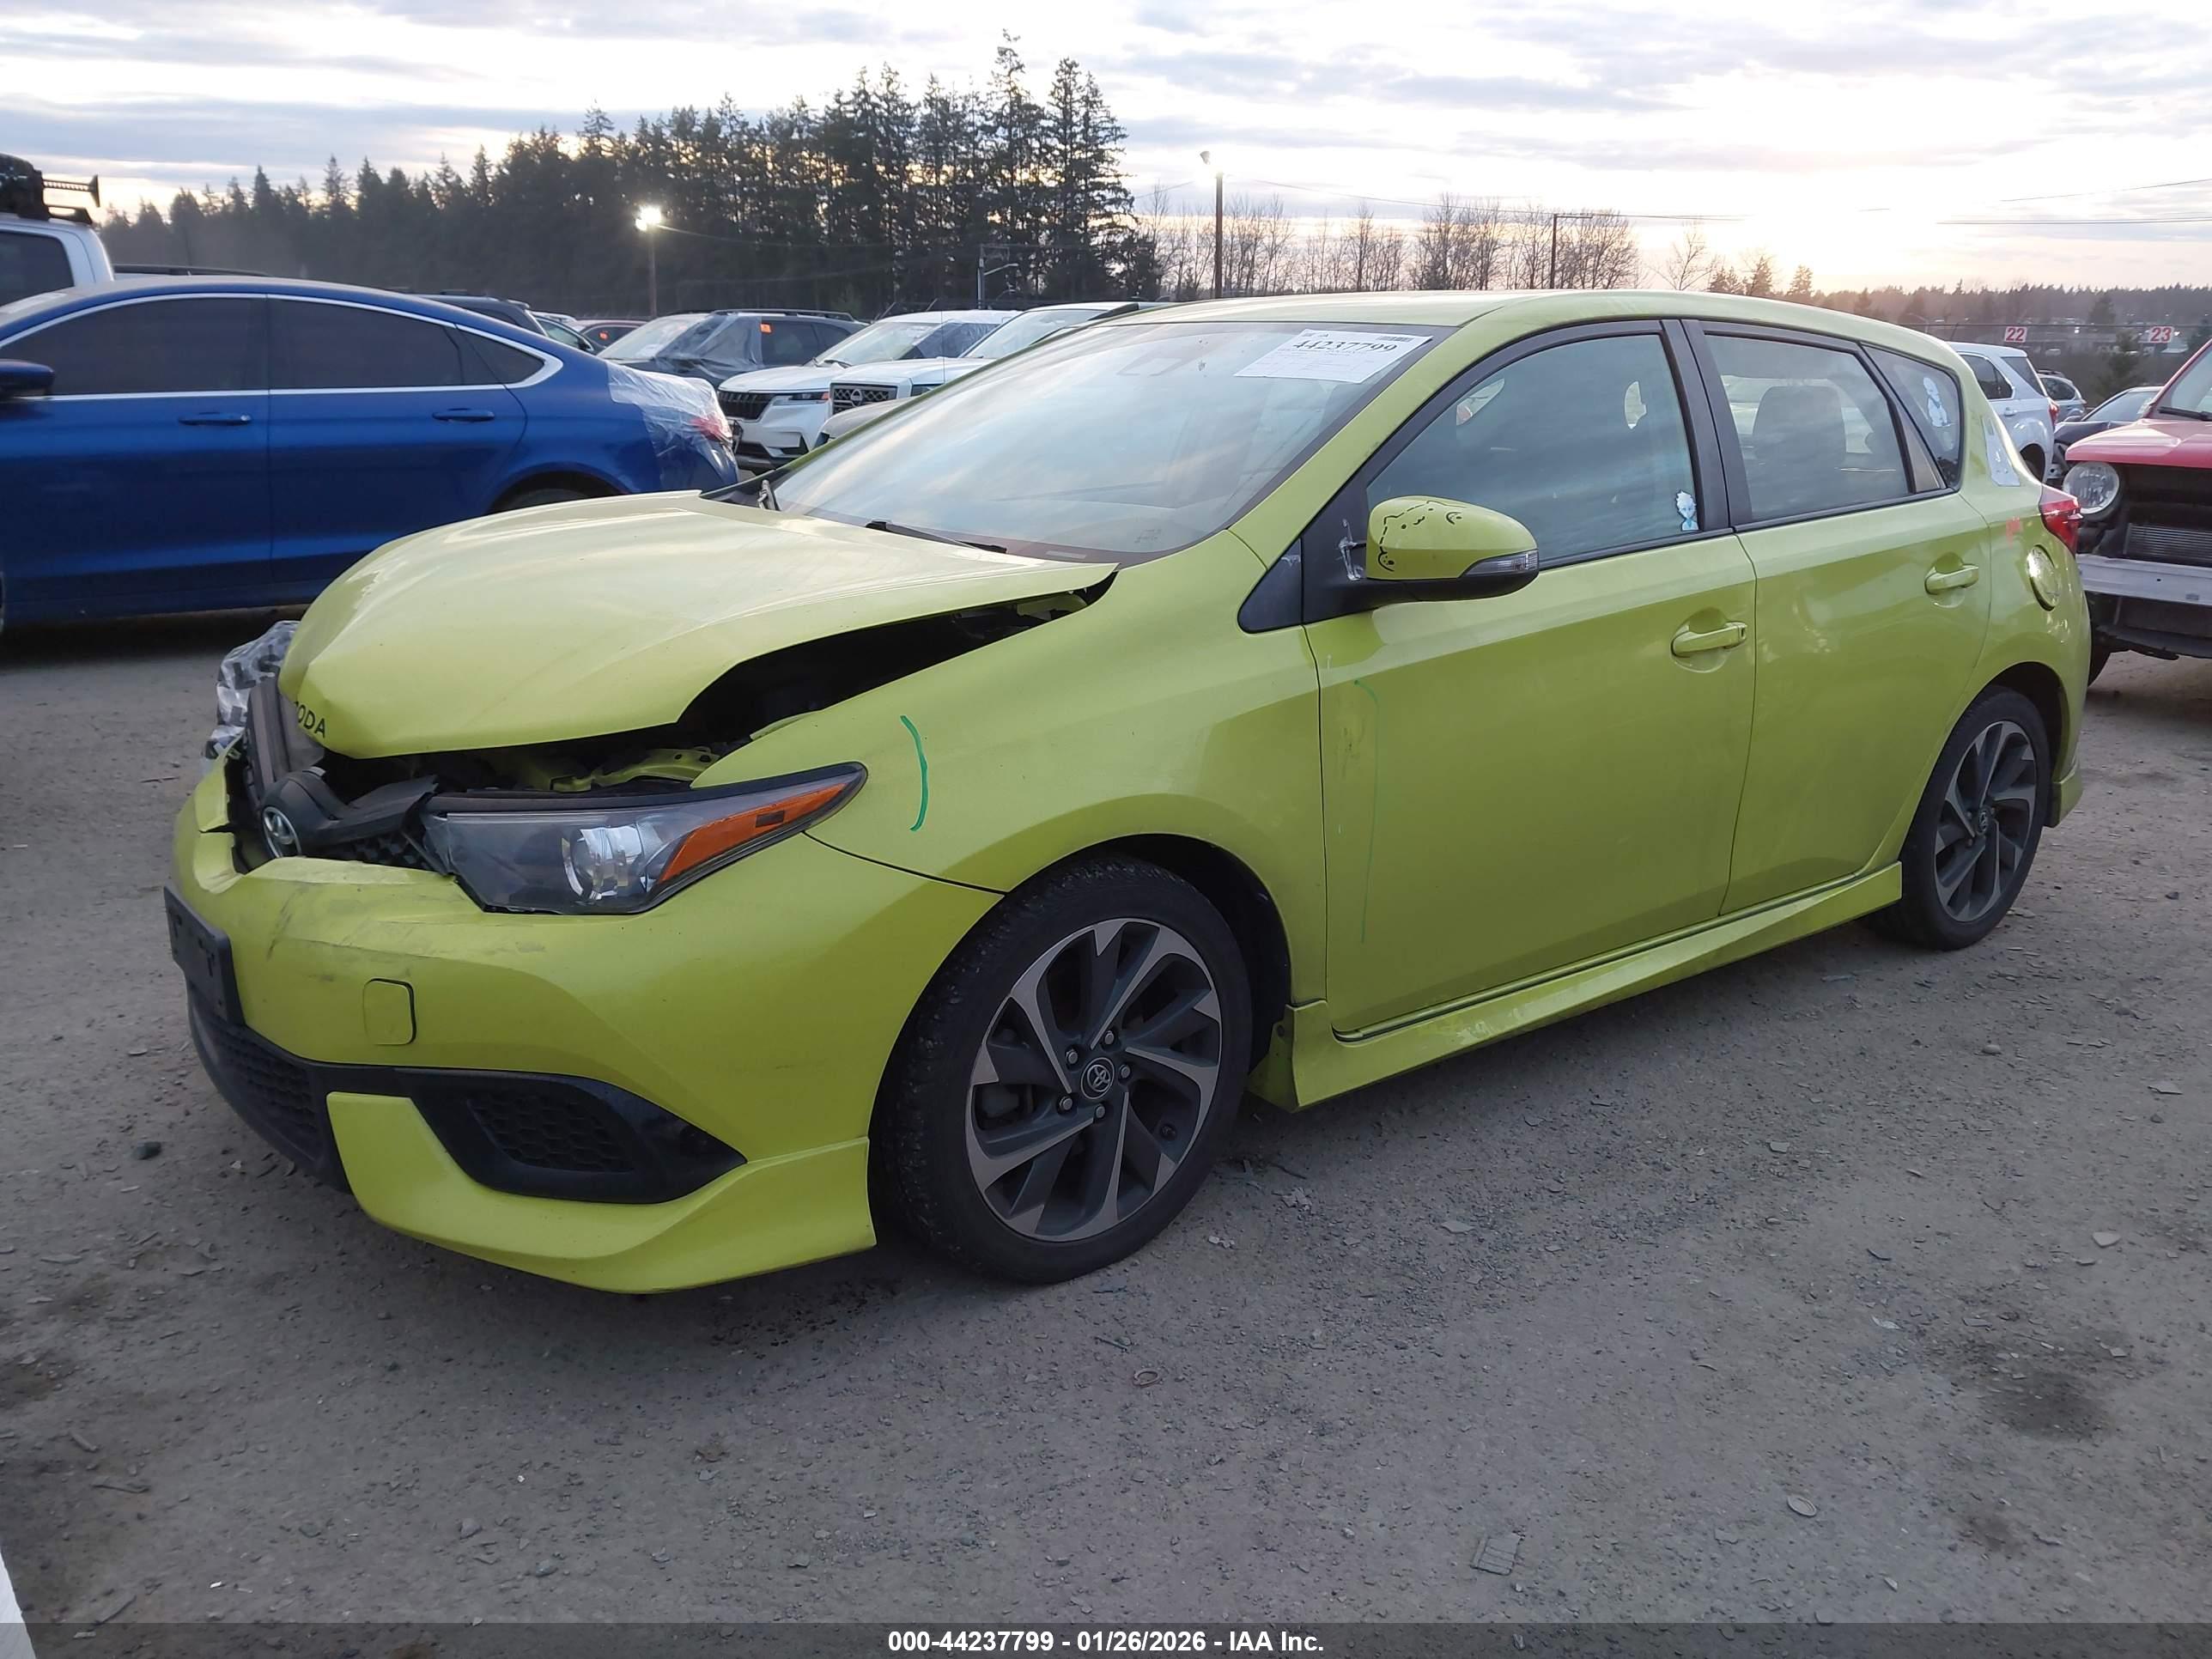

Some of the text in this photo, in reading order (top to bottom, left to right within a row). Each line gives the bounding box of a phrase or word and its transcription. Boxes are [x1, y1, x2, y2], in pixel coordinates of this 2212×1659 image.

[2006, 327, 2025, 341] 22
[2150, 327, 2172, 342] 23
[1292, 340, 1398, 352] 44237799
